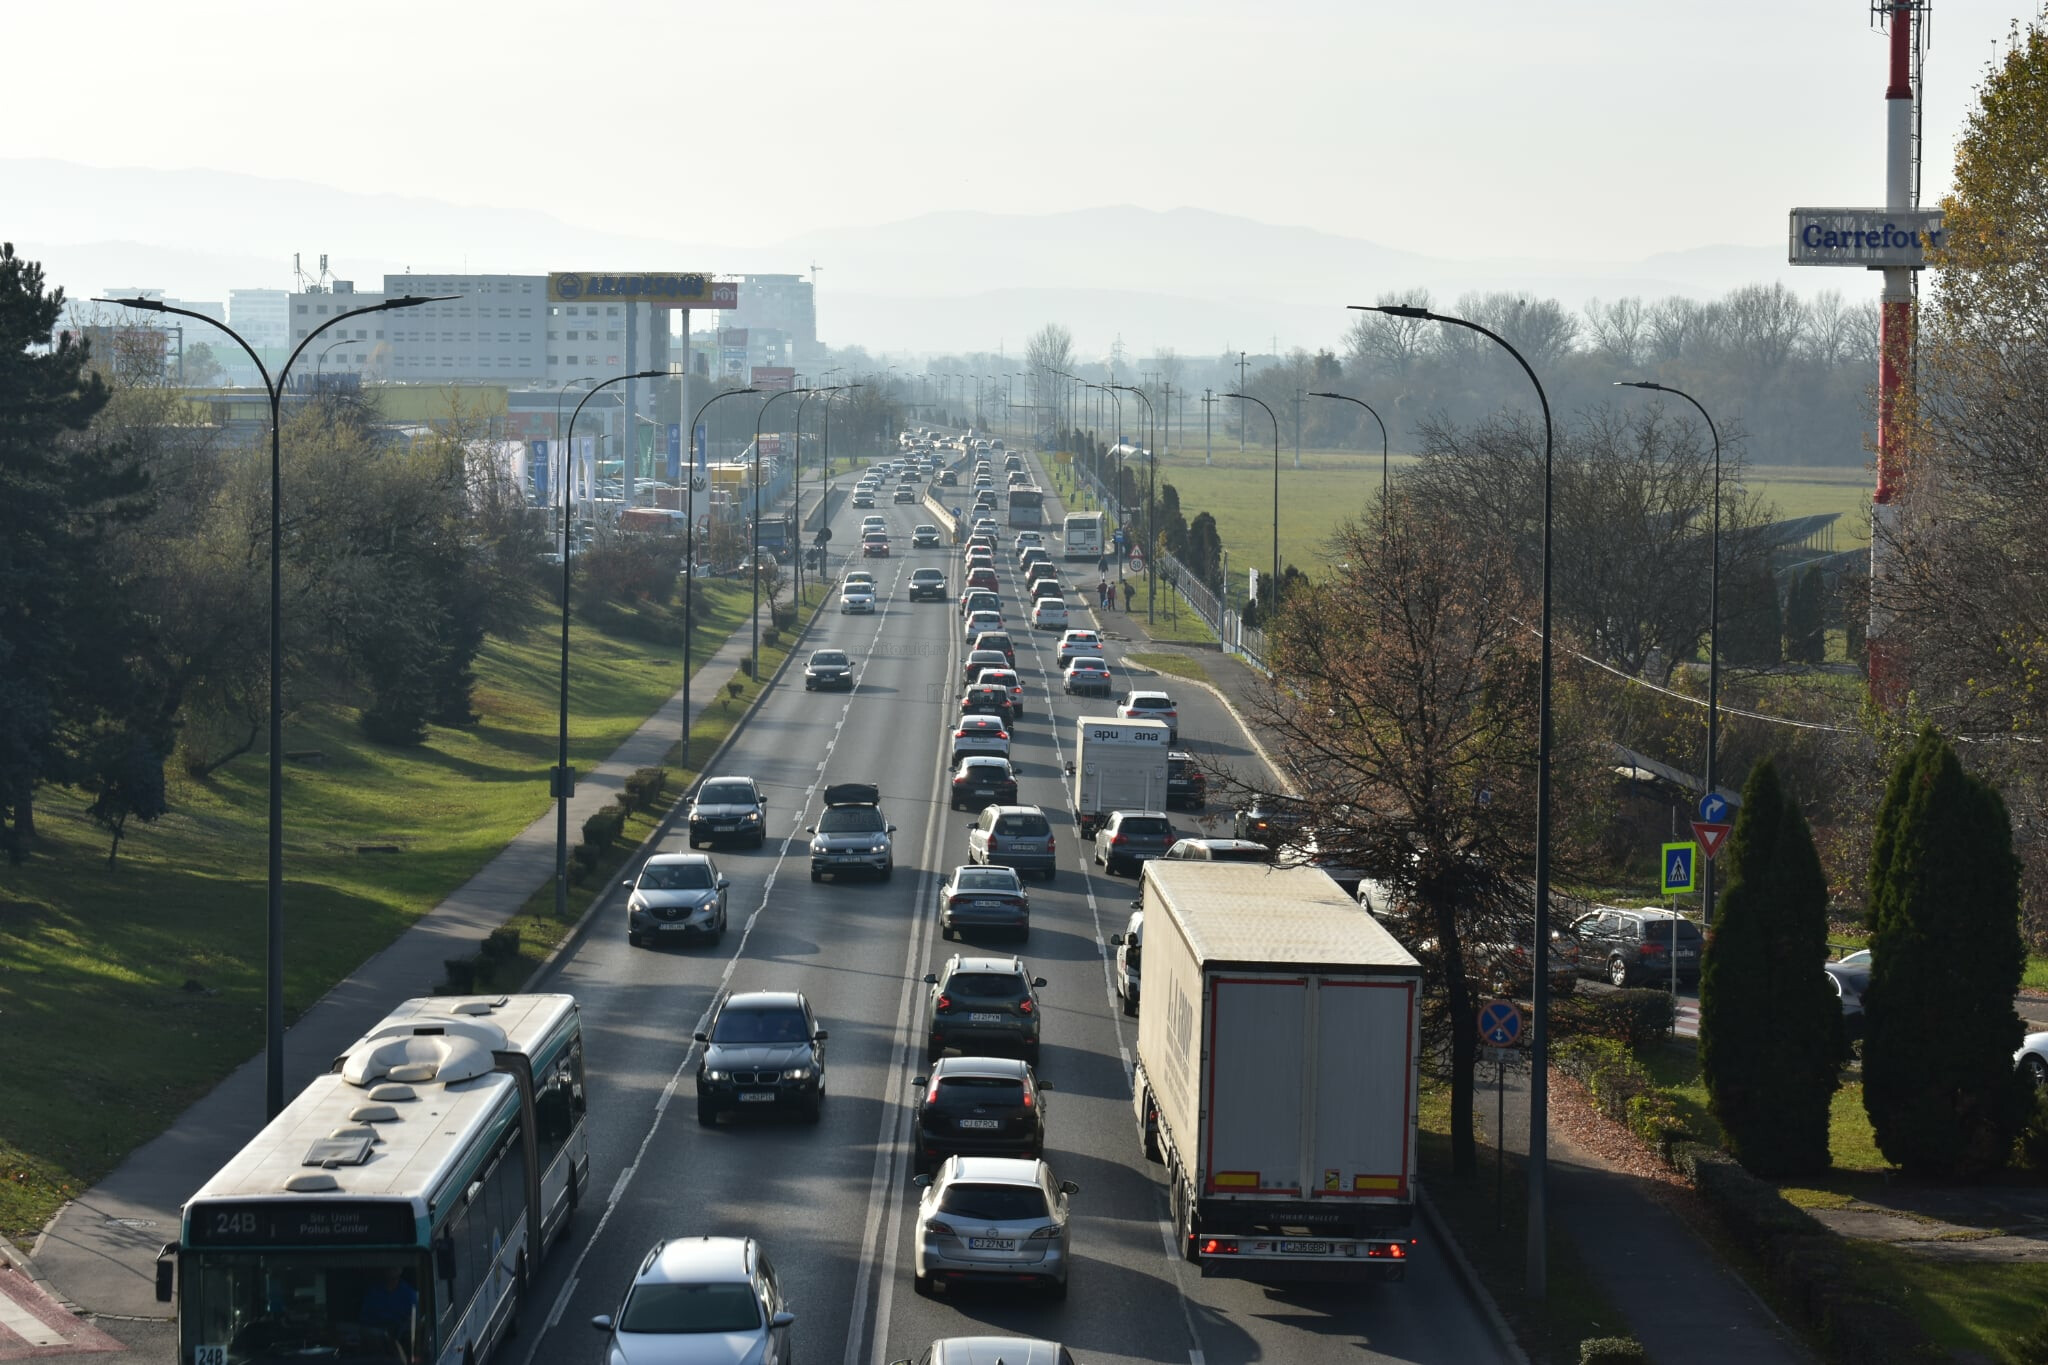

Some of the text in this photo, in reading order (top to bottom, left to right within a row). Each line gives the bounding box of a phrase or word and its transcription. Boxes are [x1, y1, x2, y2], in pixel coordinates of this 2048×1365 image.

[1802, 223, 1942, 249] Carrefour
[1132, 561, 1141, 570] 50
[1094, 730, 1119, 741] apu
[1134, 732, 1159, 741] ana
[217, 1212, 257, 1233] 24B
[300, 1223, 369, 1234] Polus Center
[996, 1240, 1013, 1249] NLM
[199, 1348, 224, 1365] 24B
